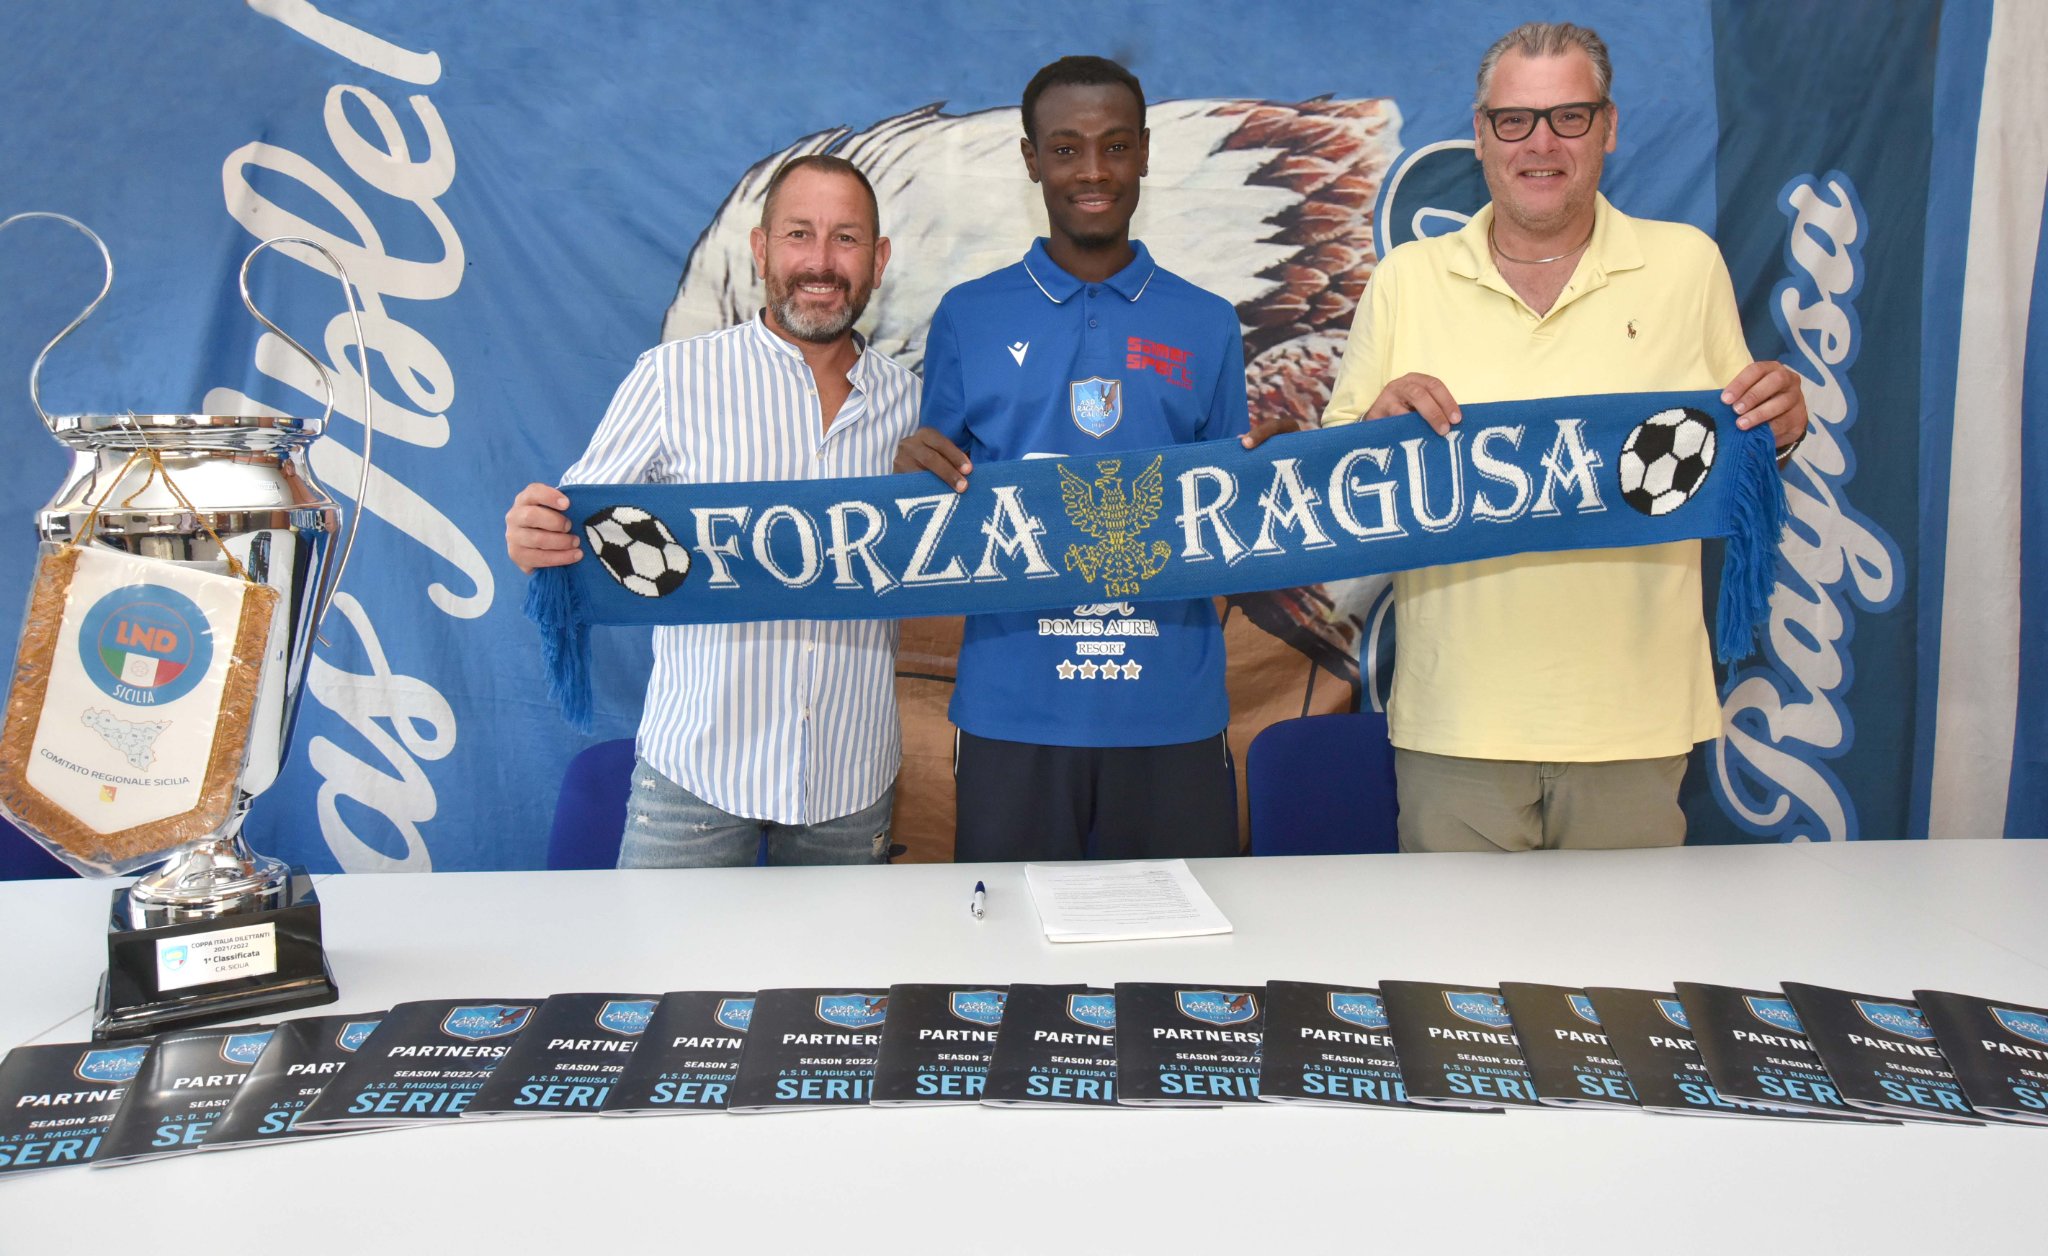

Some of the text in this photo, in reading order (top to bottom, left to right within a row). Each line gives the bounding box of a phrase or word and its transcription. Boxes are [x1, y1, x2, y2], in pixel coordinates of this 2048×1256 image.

[689, 418, 1607, 597] FORZA RAGUSA
[1104, 582, 1140, 597] 1949
[1039, 619, 1159, 636] DOMUS AUREA
[115, 620, 178, 654] LND
[1077, 642, 1125, 655] RESORT
[113, 684, 155, 704] SICILIA
[40, 748, 190, 786] COMITATO REGIONALE SICILIA
[191, 932, 270, 949] COPPA ITALIA DILETTANTI
[214, 942, 249, 953] 2021/2022
[213, 950, 260, 963] Classificata
[228, 962, 249, 970] SICILIA
[547, 1039, 638, 1052] PARTNE
[1034, 1030, 1114, 1047] PARTNE
[387, 1045, 512, 1058] PARTNERS
[938, 1053, 979, 1061] SEASON
[1176, 1053, 1218, 1061] SEASON
[1321, 1053, 1364, 1064] SEASON
[1457, 1053, 1500, 1064] SEASON
[684, 1061, 728, 1069] SEASON
[800, 1057, 842, 1065] SEASON
[1051, 1056, 1092, 1065] SEASON
[1765, 1056, 1813, 1070] SEASON
[394, 1070, 441, 1078] SEASON
[555, 1063, 624, 1073] SEASON 202
[779, 1069, 811, 1077] A.S.D.
[1030, 1066, 1061, 1074] A.S.D.
[1065, 1068, 1107, 1078] RAGUSA
[1160, 1064, 1191, 1072] A.S.D.
[1194, 1065, 1235, 1074] RAGUSA
[1303, 1063, 1335, 1073] A.S.D.
[1339, 1067, 1381, 1077] RAGUSA
[1443, 1063, 1475, 1072] A.S.D.
[1478, 1067, 1520, 1077] RAGUSA
[1573, 1065, 1606, 1075] A.S.D.
[1752, 1065, 1786, 1077] A.S.D.
[1885, 1062, 1934, 1076] SEASON
[915, 1074, 986, 1095] SER
[1446, 1072, 1539, 1101] SERI
[1873, 1070, 1960, 1090] A.S.D. RAGUSA
[649, 1082, 728, 1104] SER
[1026, 1075, 1113, 1100] SERI
[1576, 1074, 1639, 1101] SE
[1756, 1074, 1846, 1106] SER
[16, 1088, 129, 1108] PARTNE
[348, 1092, 477, 1113] SERIE
[513, 1084, 610, 1107] SERI
[1879, 1079, 1972, 1113] SER
[29, 1117, 86, 1128] SEASON
[44, 1128, 98, 1139] RAGUSA
